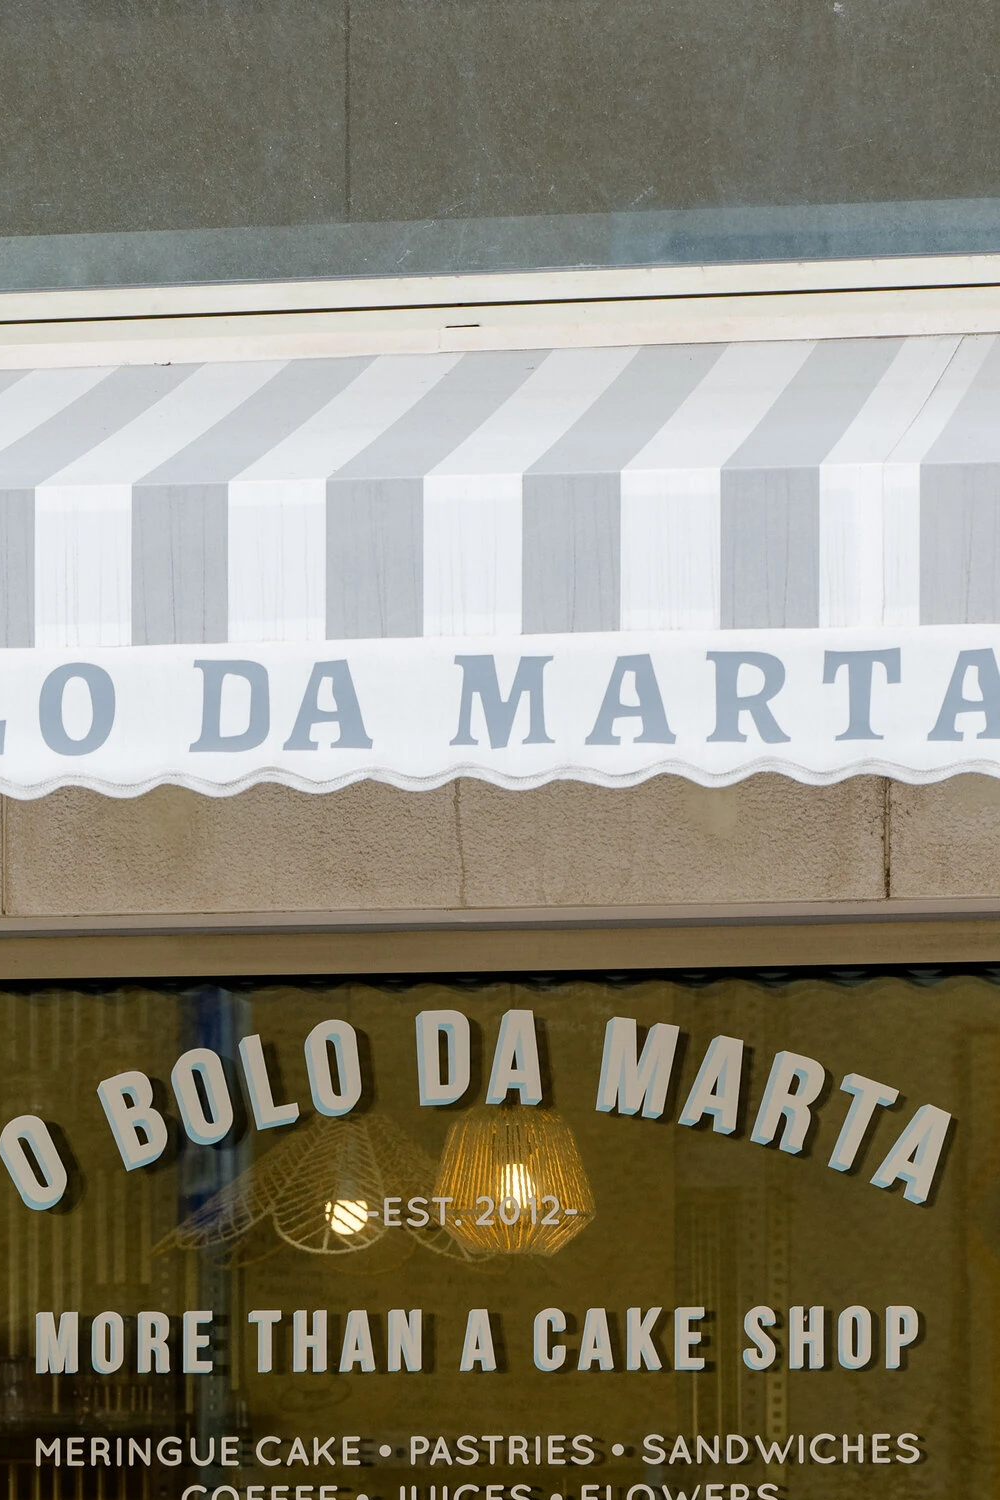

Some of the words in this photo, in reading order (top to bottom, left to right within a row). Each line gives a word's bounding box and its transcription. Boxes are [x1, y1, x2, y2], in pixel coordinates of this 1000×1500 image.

[189, 658, 374, 753] DA
[449, 646, 1000, 750] MARTA
[96, 1018, 363, 1172] BOLO
[415, 1008, 543, 1106] DA
[595, 1016, 952, 1205] MARTA
[35, 1310, 213, 1374] MORE
[248, 1309, 422, 1373] THAN
[459, 1308, 497, 1372] A
[533, 1306, 705, 1372] CAKE
[742, 1305, 919, 1371] SHOP
[35, 1436, 240, 1467] MERINGUE
[255, 1436, 361, 1466] CAKE
[410, 1434, 595, 1466] PASTRIES
[642, 1433, 920, 1465] SANDWICHES
